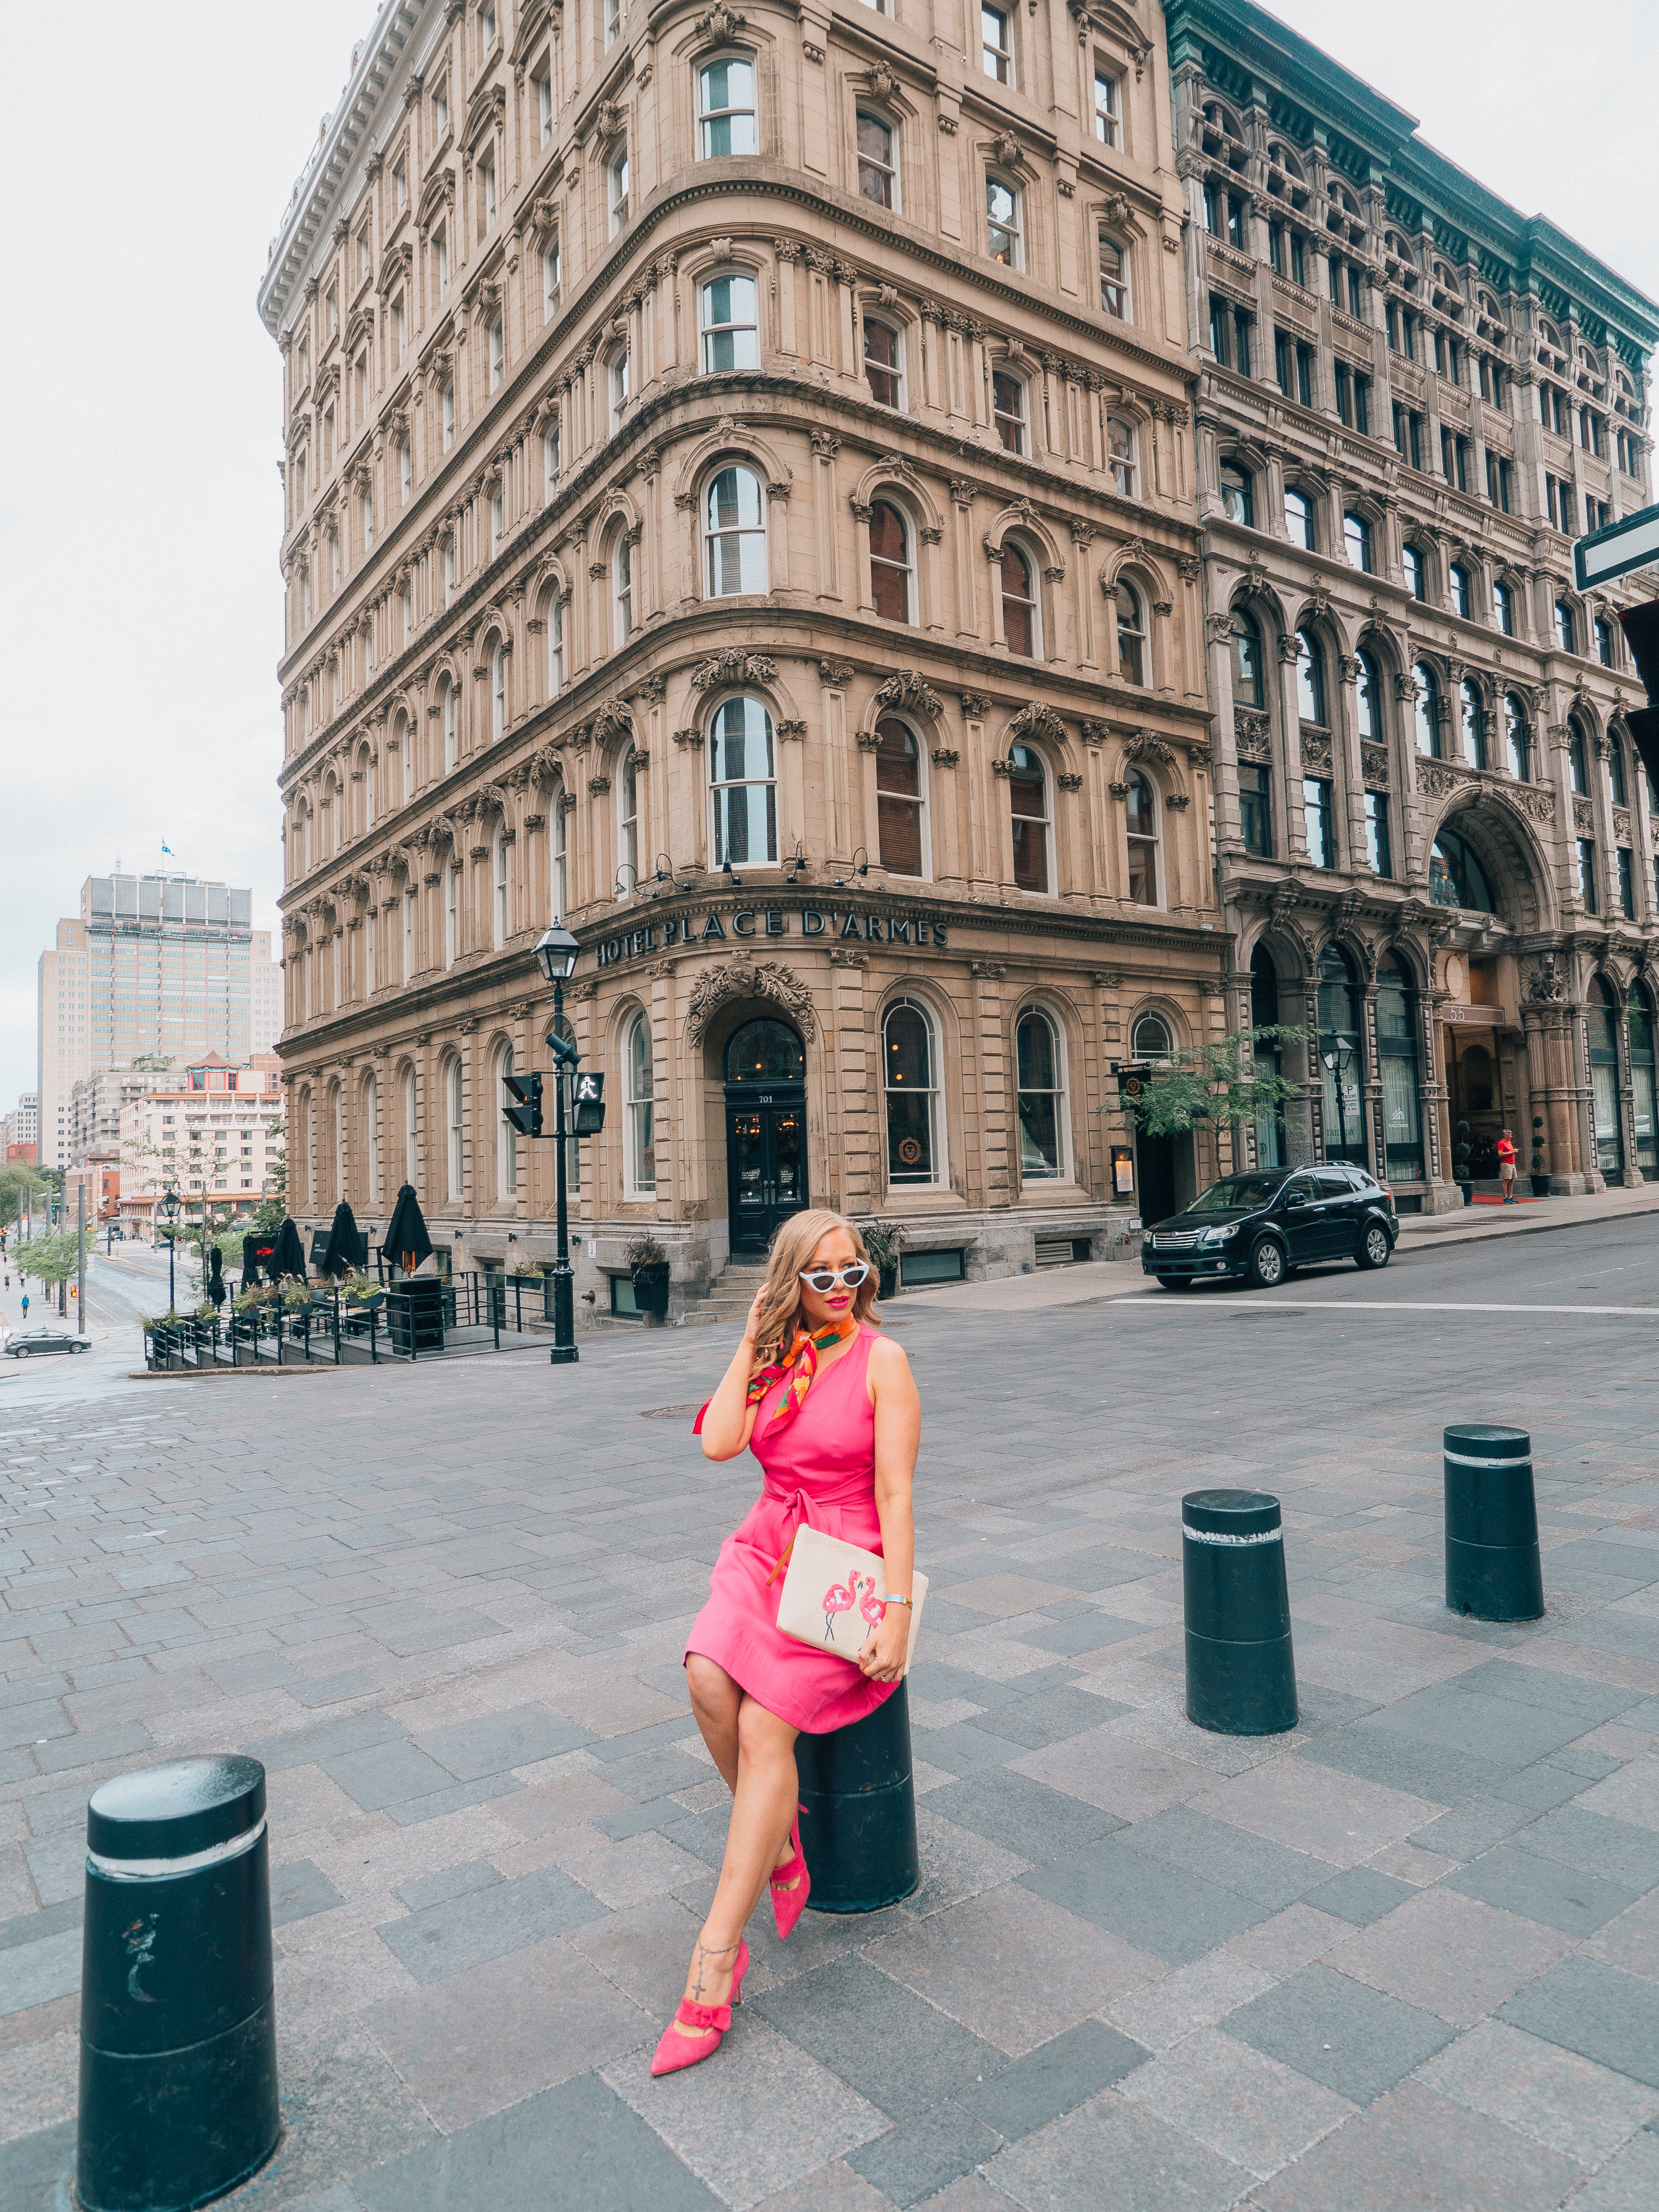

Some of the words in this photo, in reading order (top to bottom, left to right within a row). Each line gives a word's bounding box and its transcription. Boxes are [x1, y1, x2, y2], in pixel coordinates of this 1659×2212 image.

[596, 927, 658, 967] HOTEL
[663, 909, 783, 947] PLACE
[802, 909, 949, 947] D'ARMES
[1451, 1006, 1465, 1022] 55
[1347, 1086, 1353, 1094] P
